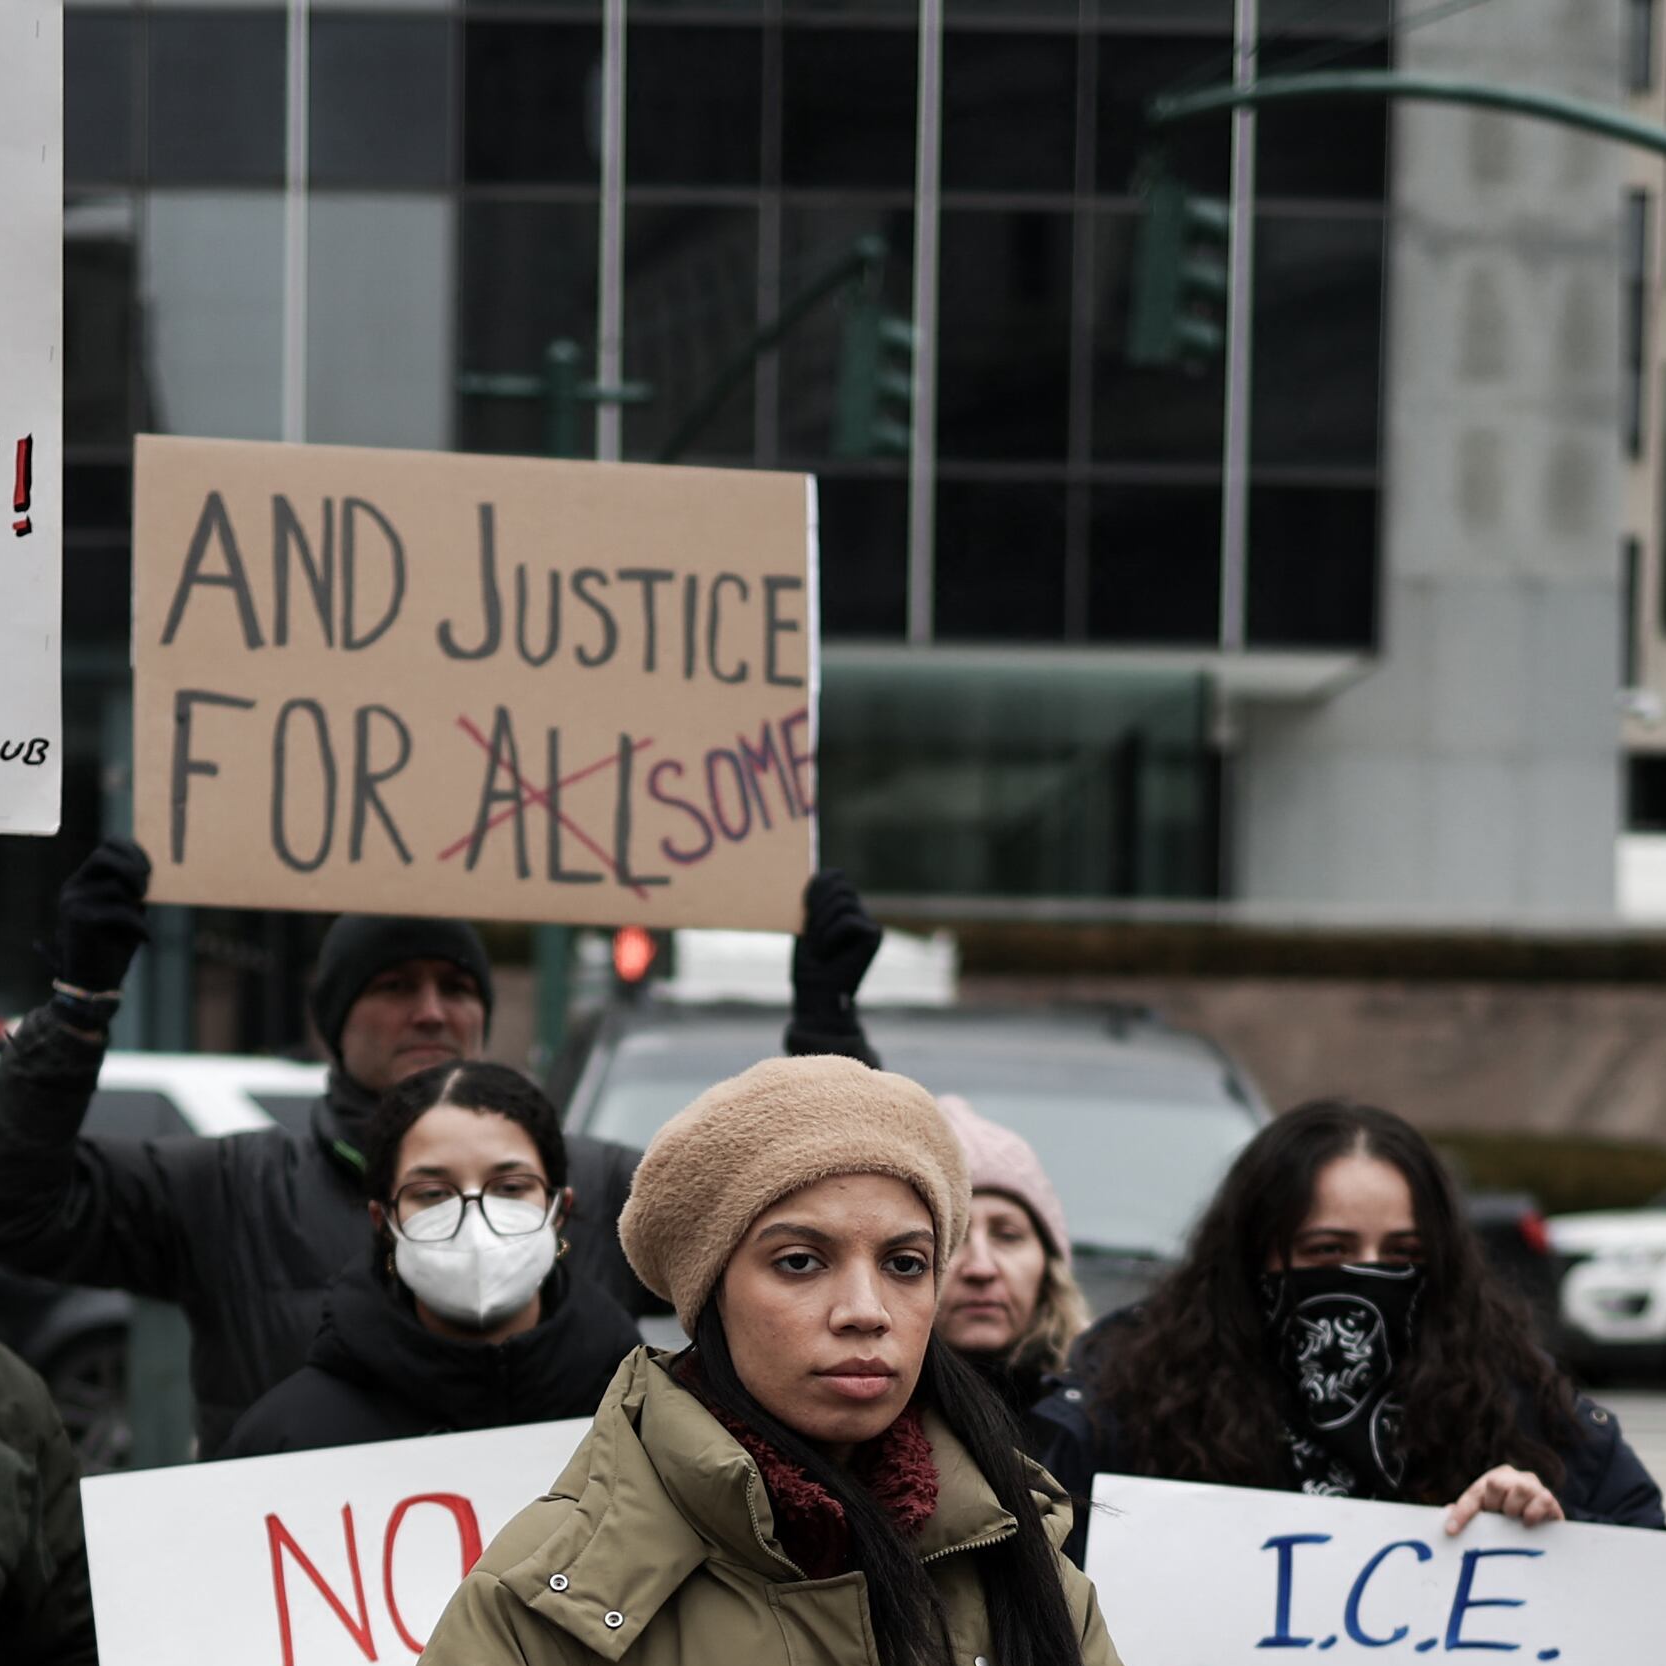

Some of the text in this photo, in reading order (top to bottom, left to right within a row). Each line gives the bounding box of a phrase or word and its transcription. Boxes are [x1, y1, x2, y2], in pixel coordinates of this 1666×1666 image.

[161, 491, 406, 650] AND
[171, 689, 818, 888] FOR ALL SOME
[1257, 1533, 1560, 1662] I.C.E.
